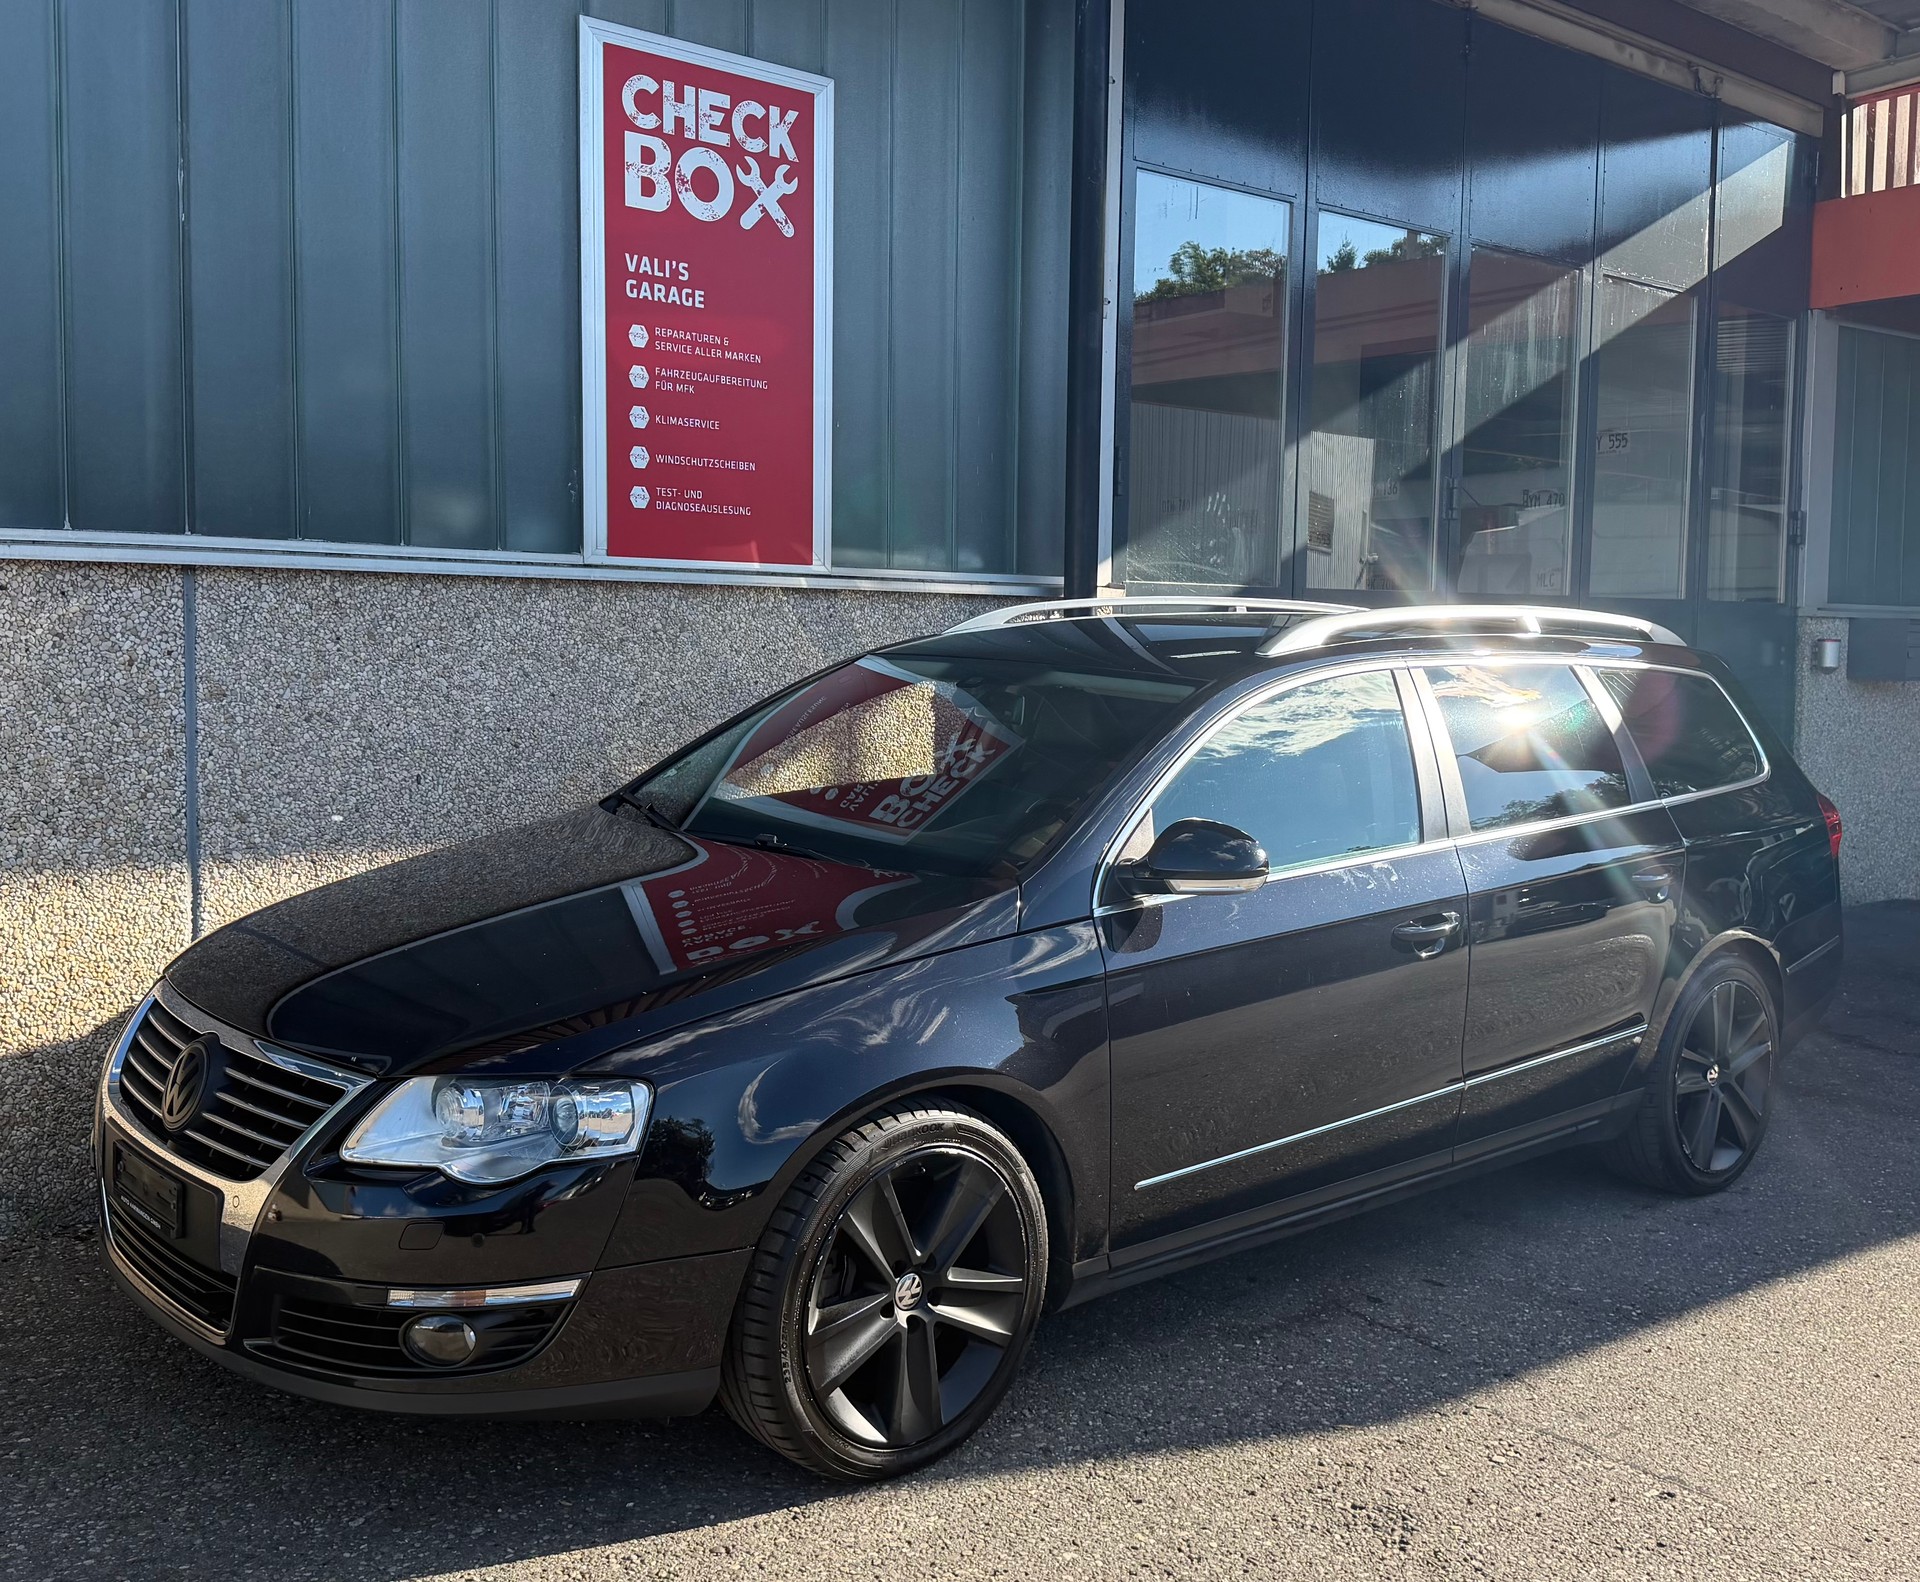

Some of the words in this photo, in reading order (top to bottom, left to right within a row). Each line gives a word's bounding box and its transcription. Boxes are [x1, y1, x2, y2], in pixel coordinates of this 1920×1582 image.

[621, 74, 799, 162] CHECK
[624, 130, 798, 238] BOX
[624, 253, 689, 281] VALI'S
[625, 279, 705, 309] GARAGE
[655, 327, 721, 345] REPARATUREN
[723, 337, 729, 346] &
[655, 341, 692, 355] SERVICE
[694, 347, 722, 359] ALLER
[724, 351, 761, 364] MARKEN
[655, 367, 768, 390] FAHRZEUGAUFBEREITUNG
[655, 380, 673, 392] FÜR
[676, 384, 695, 394] MFK
[655, 415, 720, 430] KLIMASERVICE
[1609, 432, 1628, 450] 555
[655, 454, 756, 471] WINDSCHUTZSCHEIBEN
[656, 487, 681, 497] TEST-
[684, 490, 703, 499] UND
[656, 501, 751, 516] DIAGNOSEAUSLESUNG
